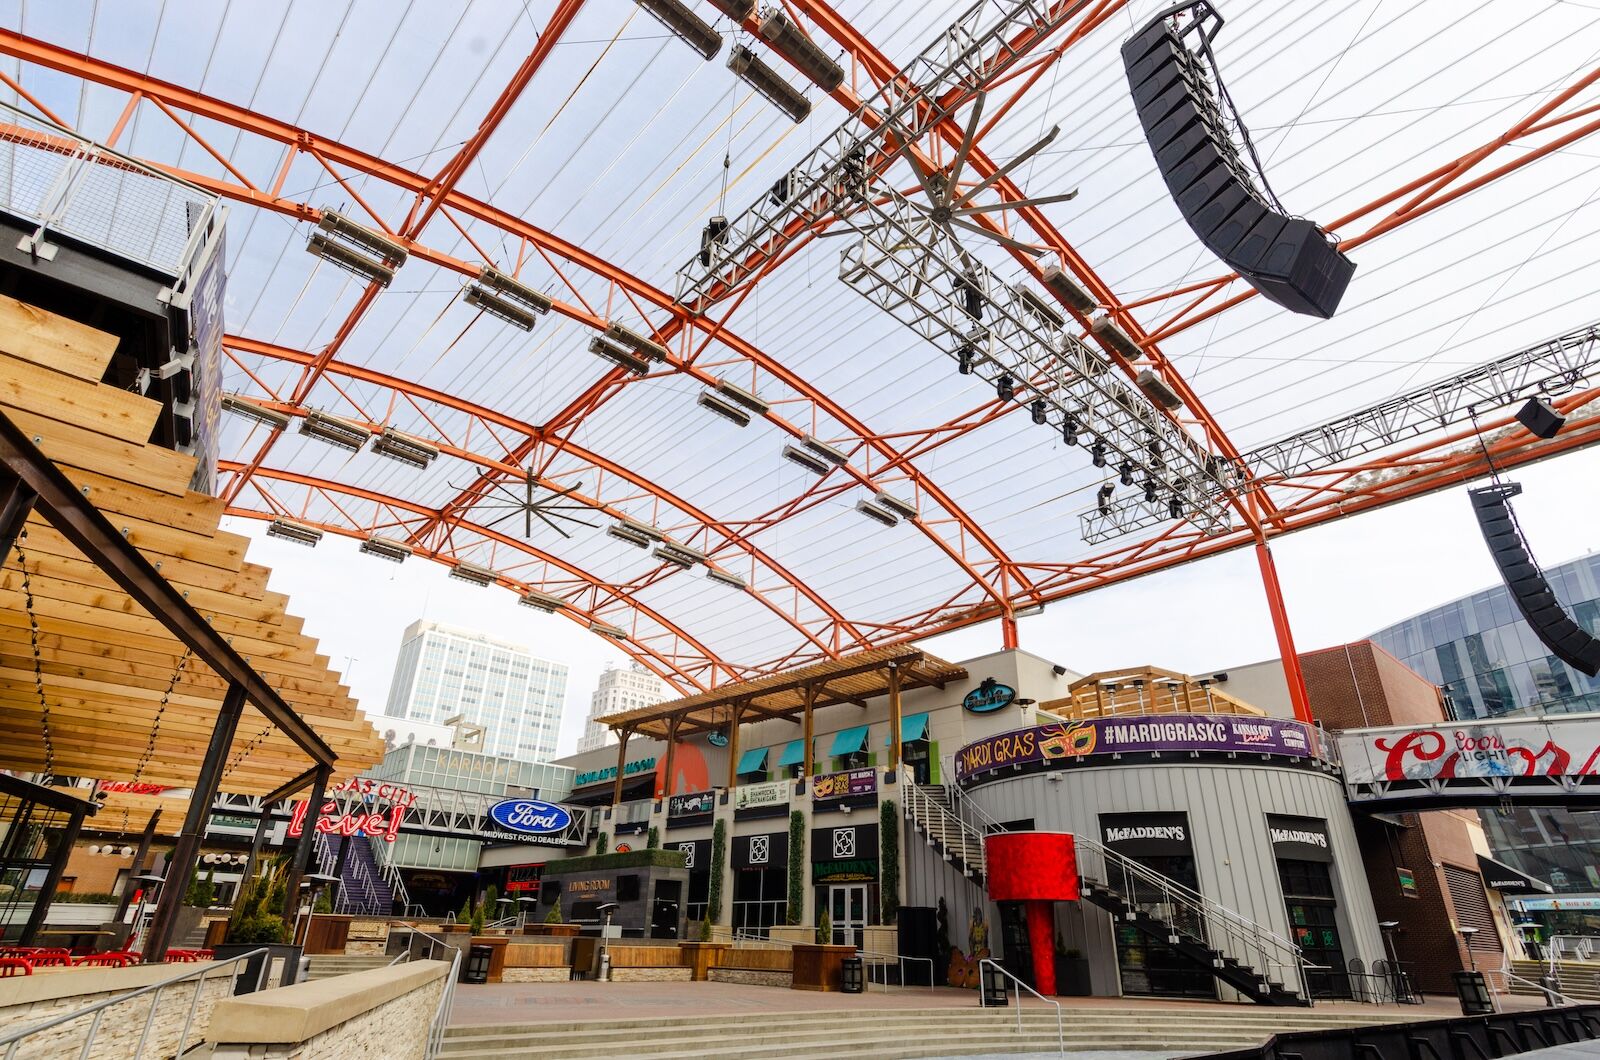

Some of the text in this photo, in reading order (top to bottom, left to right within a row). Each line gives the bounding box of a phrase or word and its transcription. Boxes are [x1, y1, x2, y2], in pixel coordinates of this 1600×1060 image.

[1104, 722, 1227, 744] #MARDIGRASKC
[1232, 723, 1273, 737] KANSAS CITY
[1280, 729, 1305, 741] SOUTHERN
[1284, 738, 1306, 749] COMFORT
[1454, 731, 1505, 751] Coors
[962, 742, 992, 774] MARDI
[994, 732, 1035, 762] GRAS
[1462, 750, 1505, 761] LIGHT
[438, 751, 520, 778] KARAOKE
[625, 757, 656, 774] MOON
[379, 785, 418, 807] CITY
[287, 799, 405, 843] Live!
[508, 803, 559, 828] Ford
[483, 830, 568, 846] MIDWEST FORD DEALERS
[1106, 826, 1186, 842] McFADDEN'S
[1270, 828, 1327, 848] McFADDEN'S
[569, 879, 611, 892] LIVING ROOM
